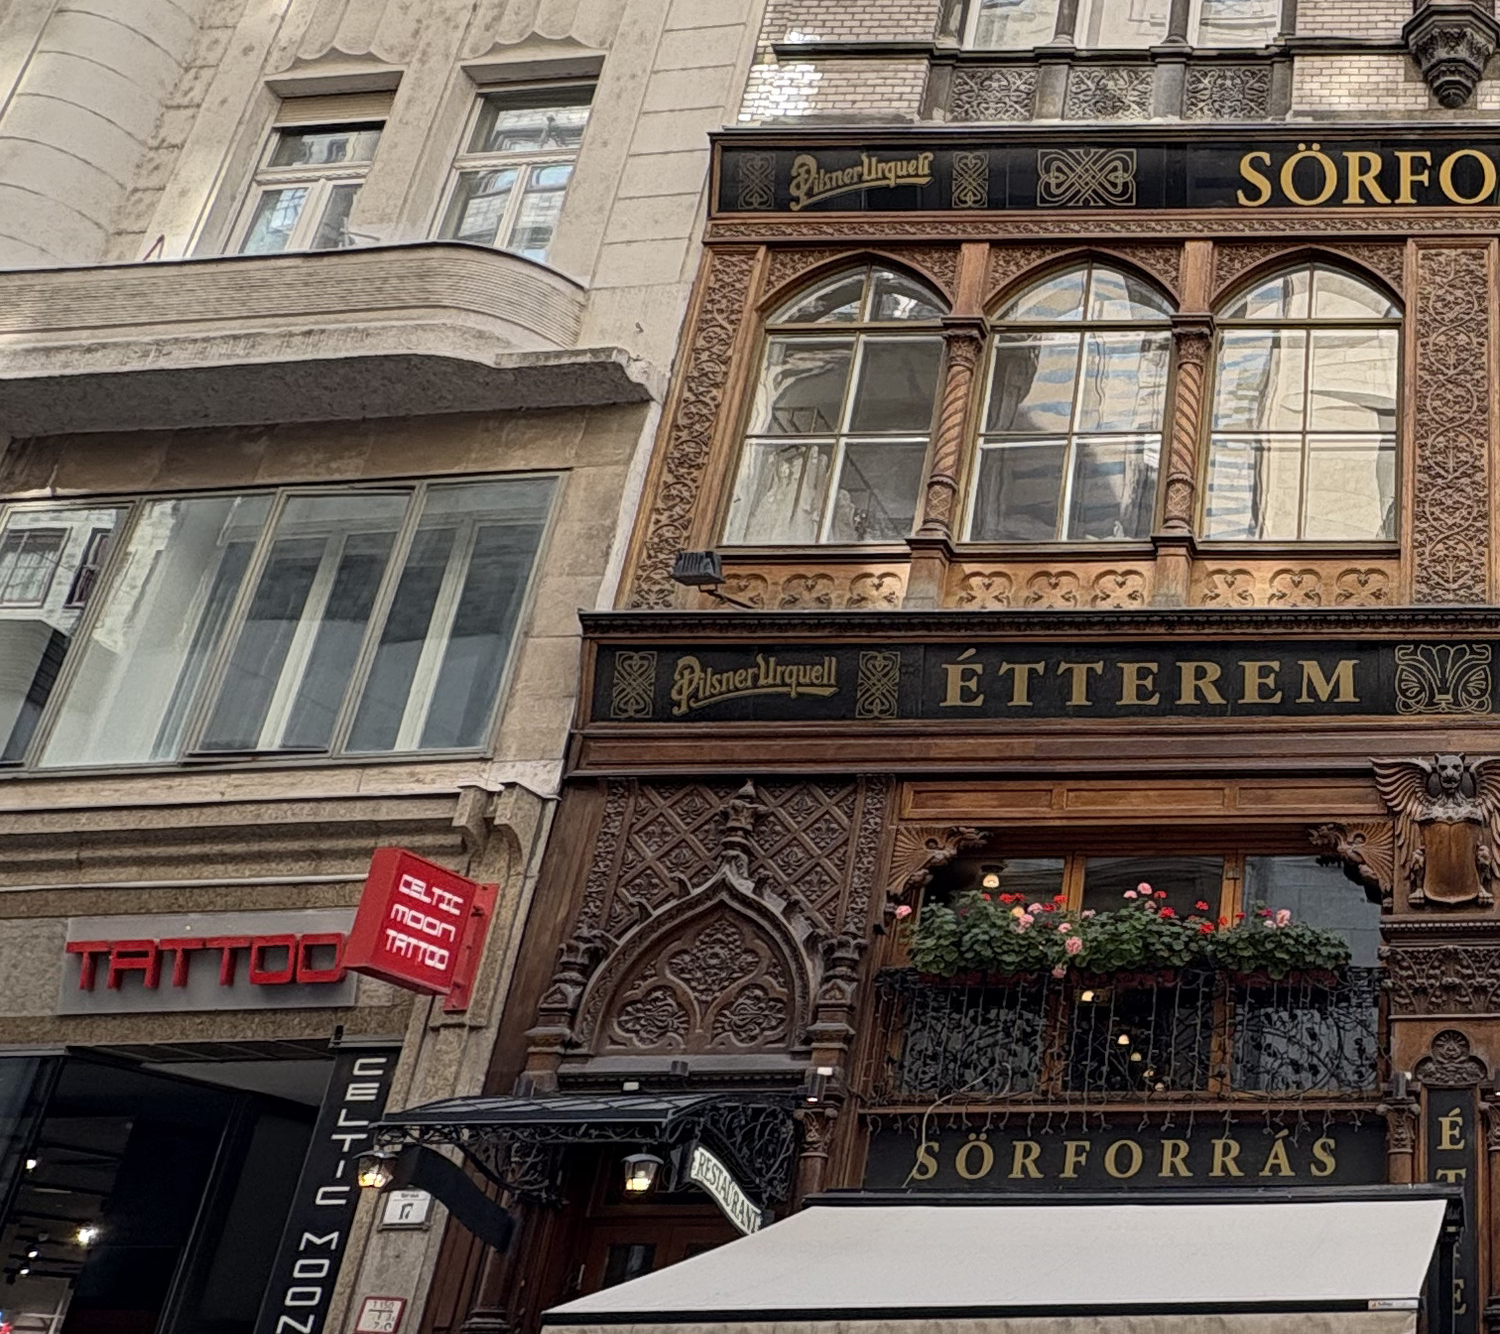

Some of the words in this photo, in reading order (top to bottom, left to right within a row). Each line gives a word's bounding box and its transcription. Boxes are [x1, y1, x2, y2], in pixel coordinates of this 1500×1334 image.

[789, 153, 862, 211] Pilsner
[859, 151, 934, 188] Urquell
[671, 655, 760, 716] Pilsner
[756, 652, 837, 698] Urquell
[939, 648, 1361, 708] ÉTTEREM
[390, 903, 456, 943] MOON
[399, 873, 464, 916] CELTIC
[66, 933, 346, 990] TATTOO
[385, 928, 450, 971] TATTOO
[315, 1057, 387, 1206] CELTIC
[910, 1129, 1339, 1181] SÖRFORRÁS
[694, 1151, 761, 1235] RESTAURANT
[275, 1231, 338, 1334] MOON
